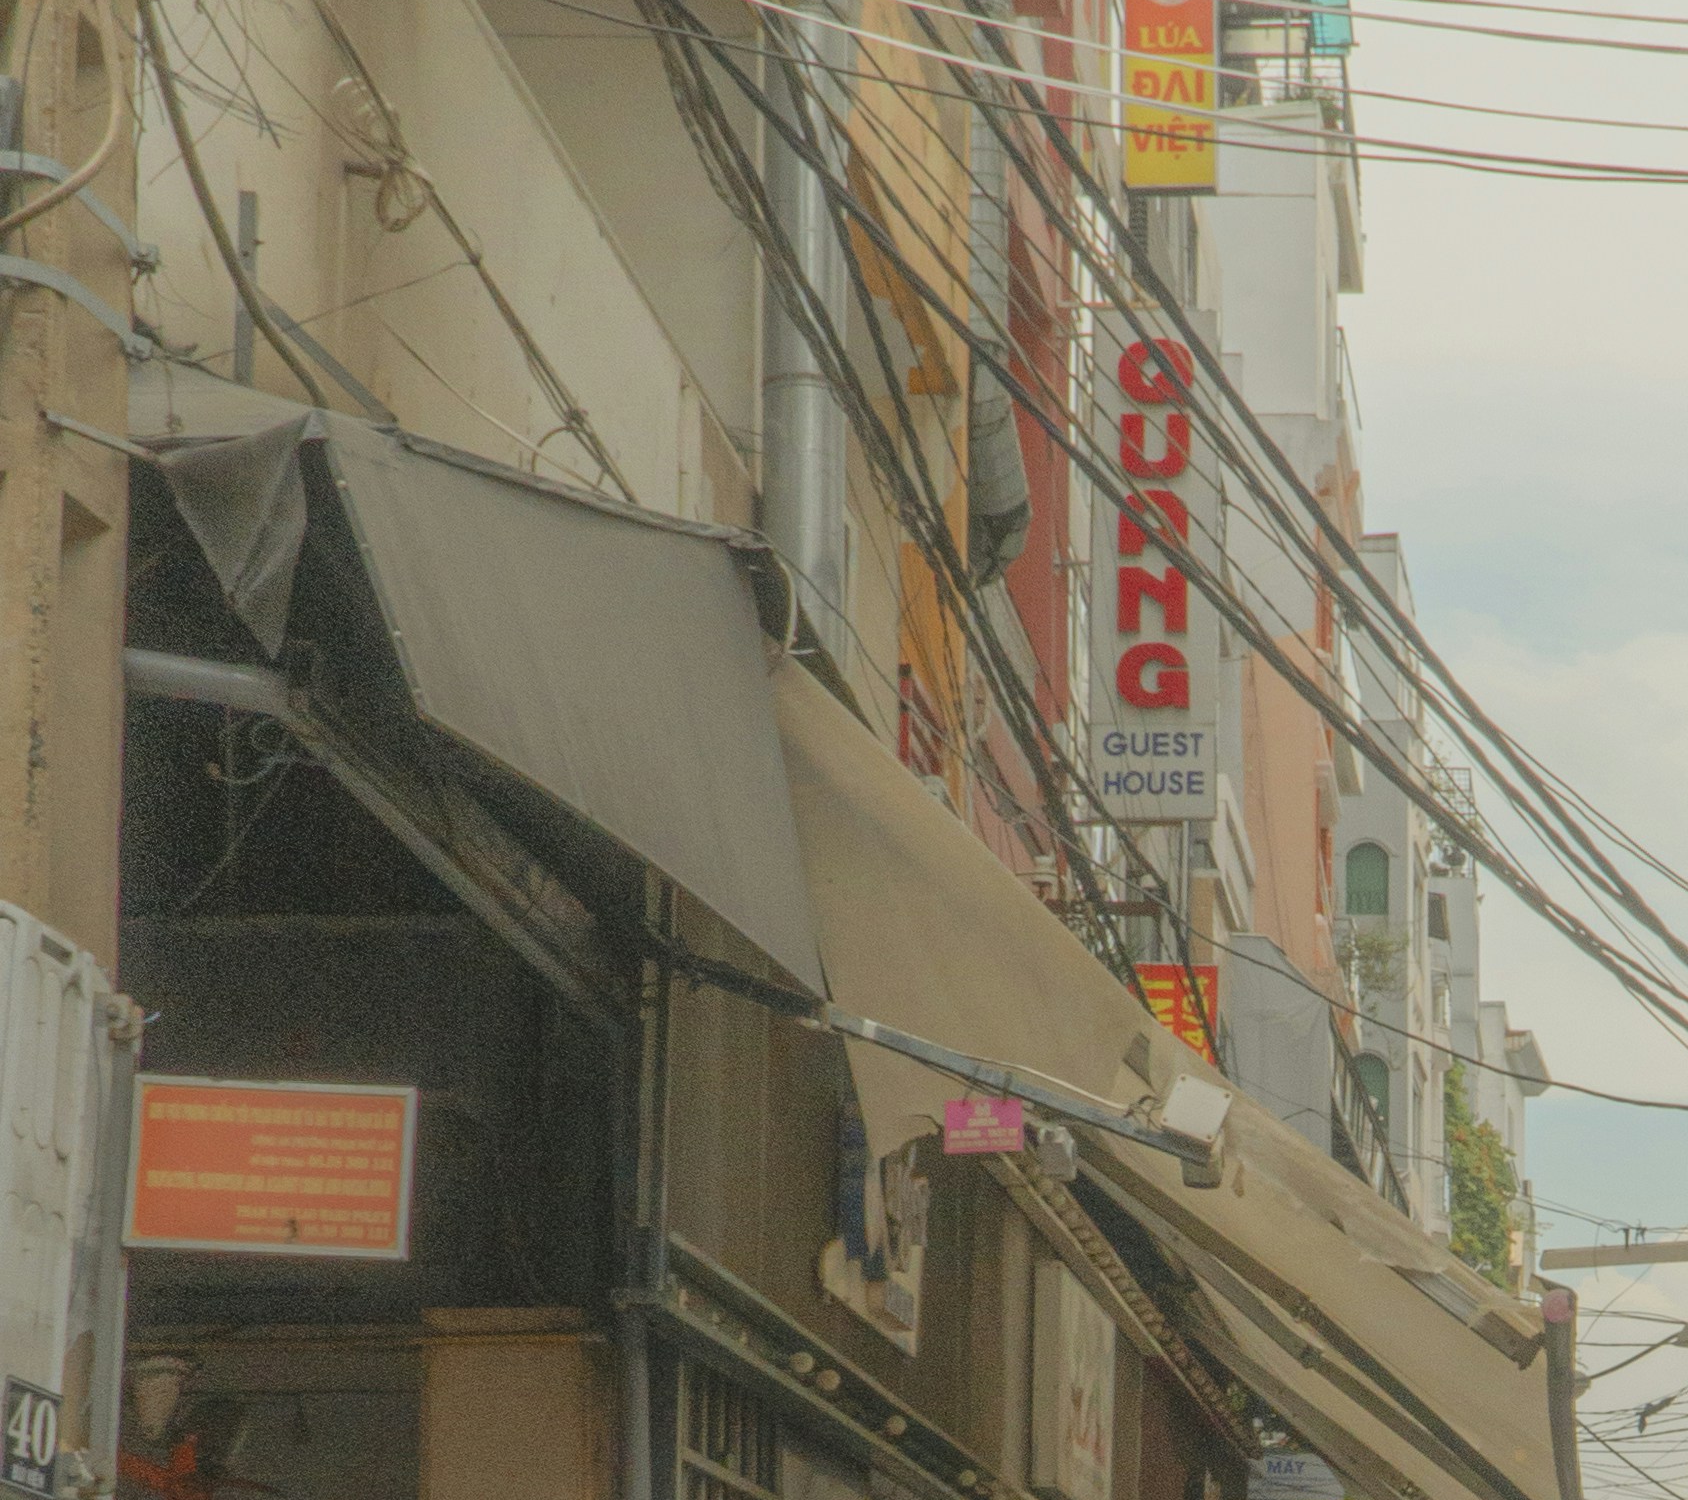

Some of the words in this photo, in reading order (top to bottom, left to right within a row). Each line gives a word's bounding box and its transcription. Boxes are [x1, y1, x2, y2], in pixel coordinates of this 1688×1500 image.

[1131, 114, 1211, 161] VIỆT
[1115, 338, 1194, 710] QUANG
[1103, 730, 1204, 757] GUEST
[1103, 769, 1205, 796] HOUSE
[7, 1392, 57, 1466] 40
